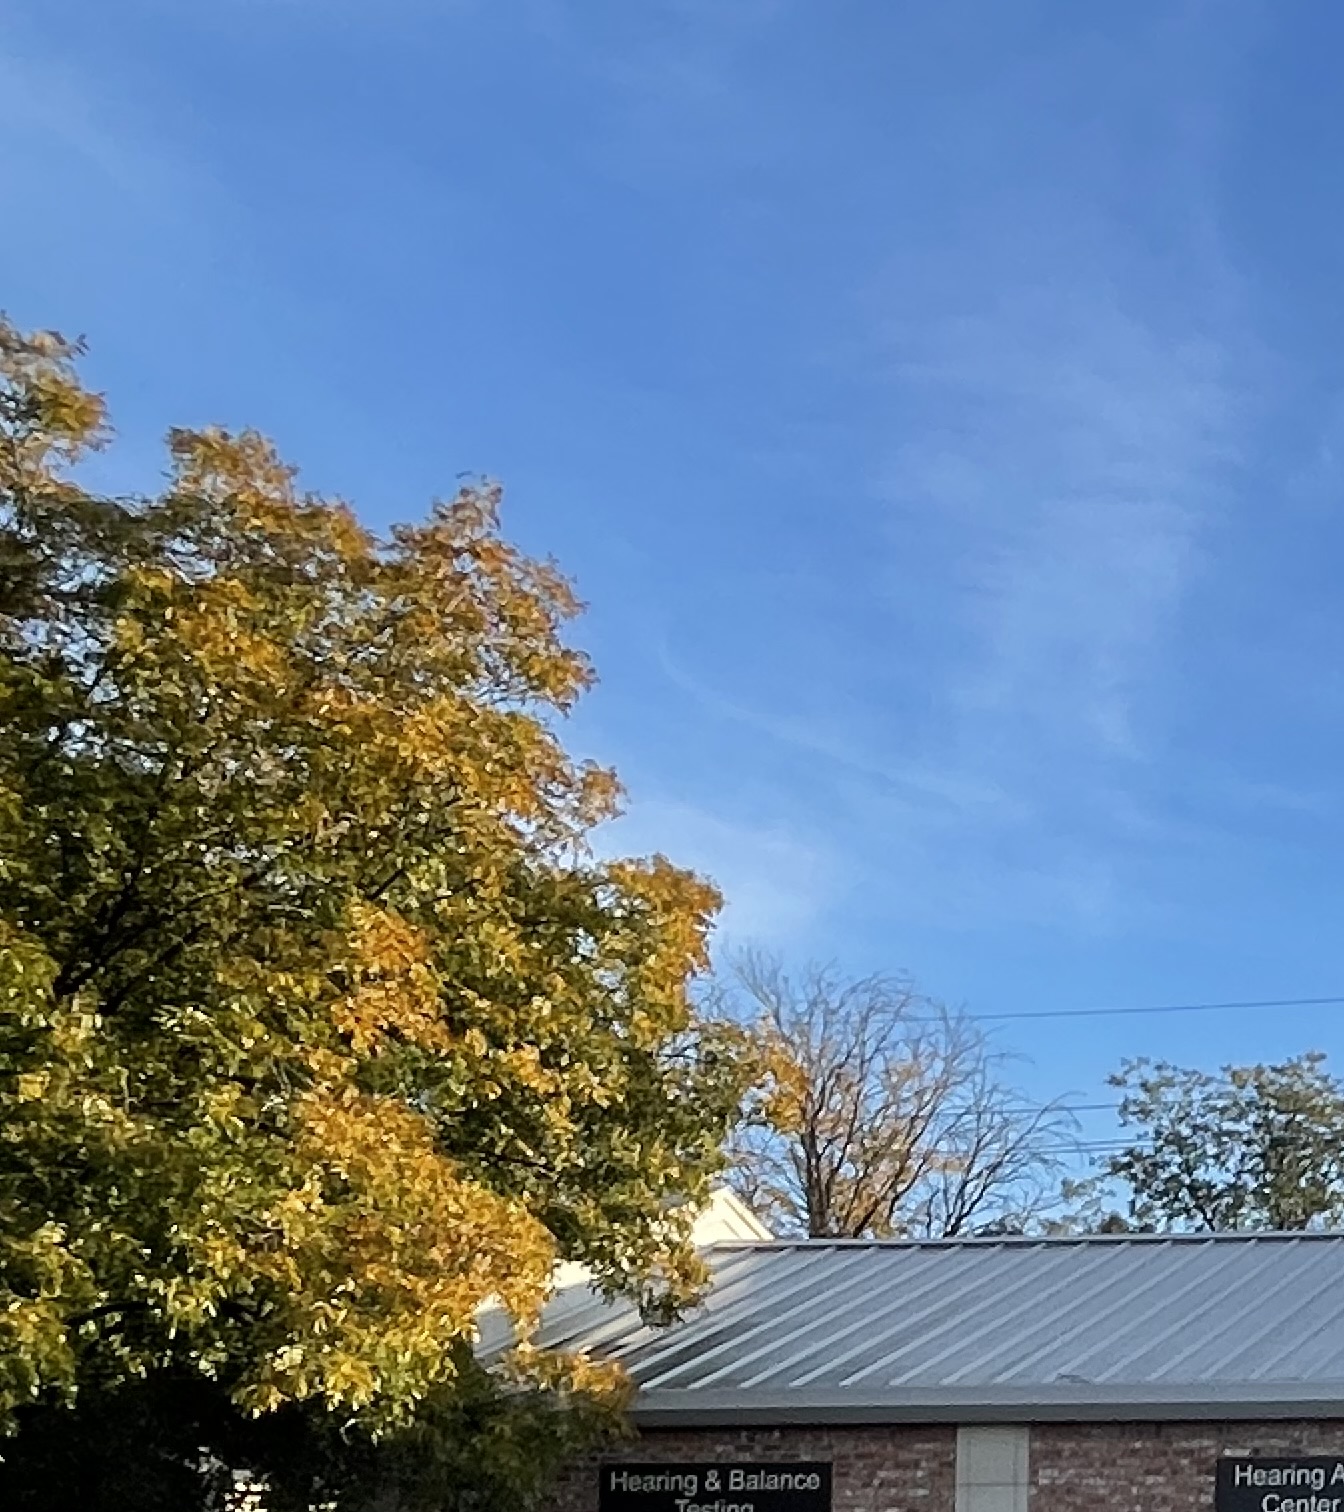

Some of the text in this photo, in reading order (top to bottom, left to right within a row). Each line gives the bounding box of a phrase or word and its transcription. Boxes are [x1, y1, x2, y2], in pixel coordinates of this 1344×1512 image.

[610, 1470, 820, 1496] Hearing & Balance
[1234, 1464, 1326, 1490] Hearing
